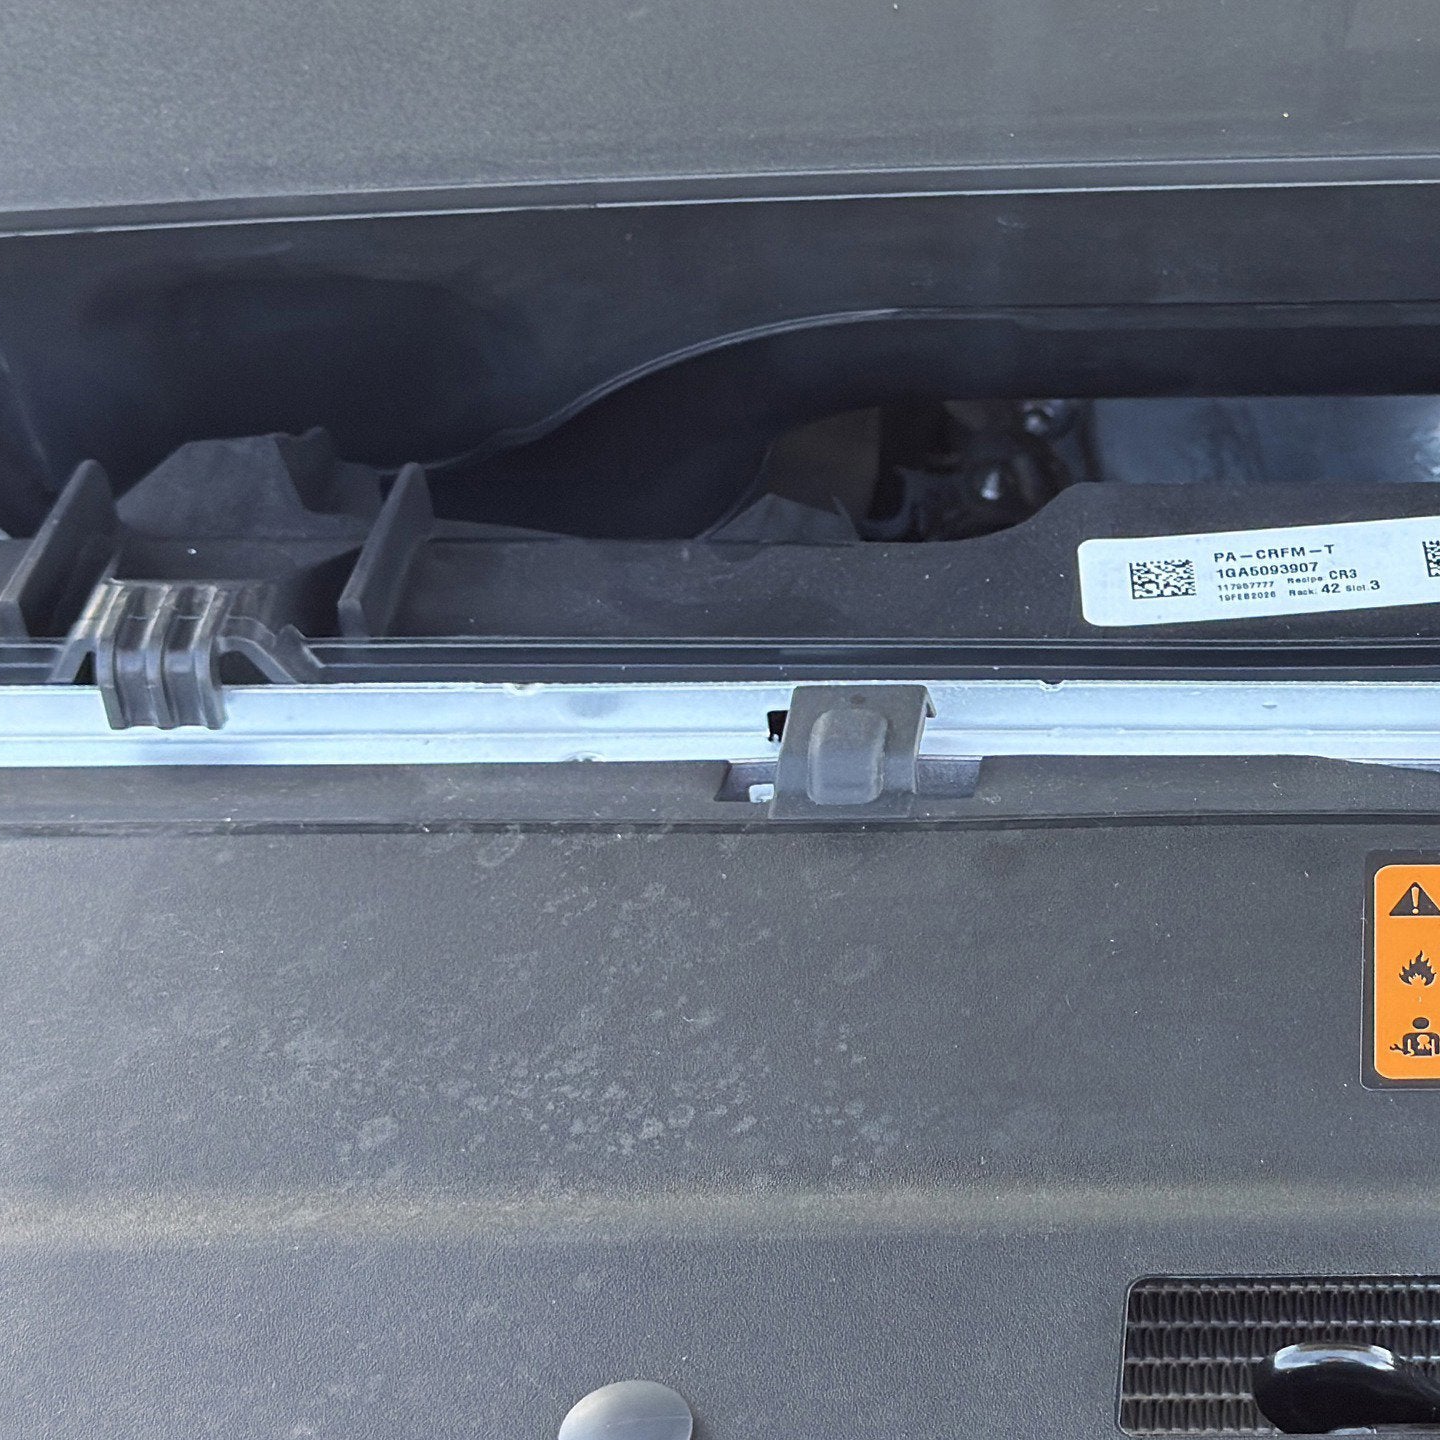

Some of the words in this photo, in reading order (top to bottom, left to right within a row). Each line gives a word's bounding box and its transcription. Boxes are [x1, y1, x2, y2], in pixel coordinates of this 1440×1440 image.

[1328, 568, 1358, 581] CR3
[1321, 582, 1341, 594] 42
[1369, 579, 1381, 591] 3
